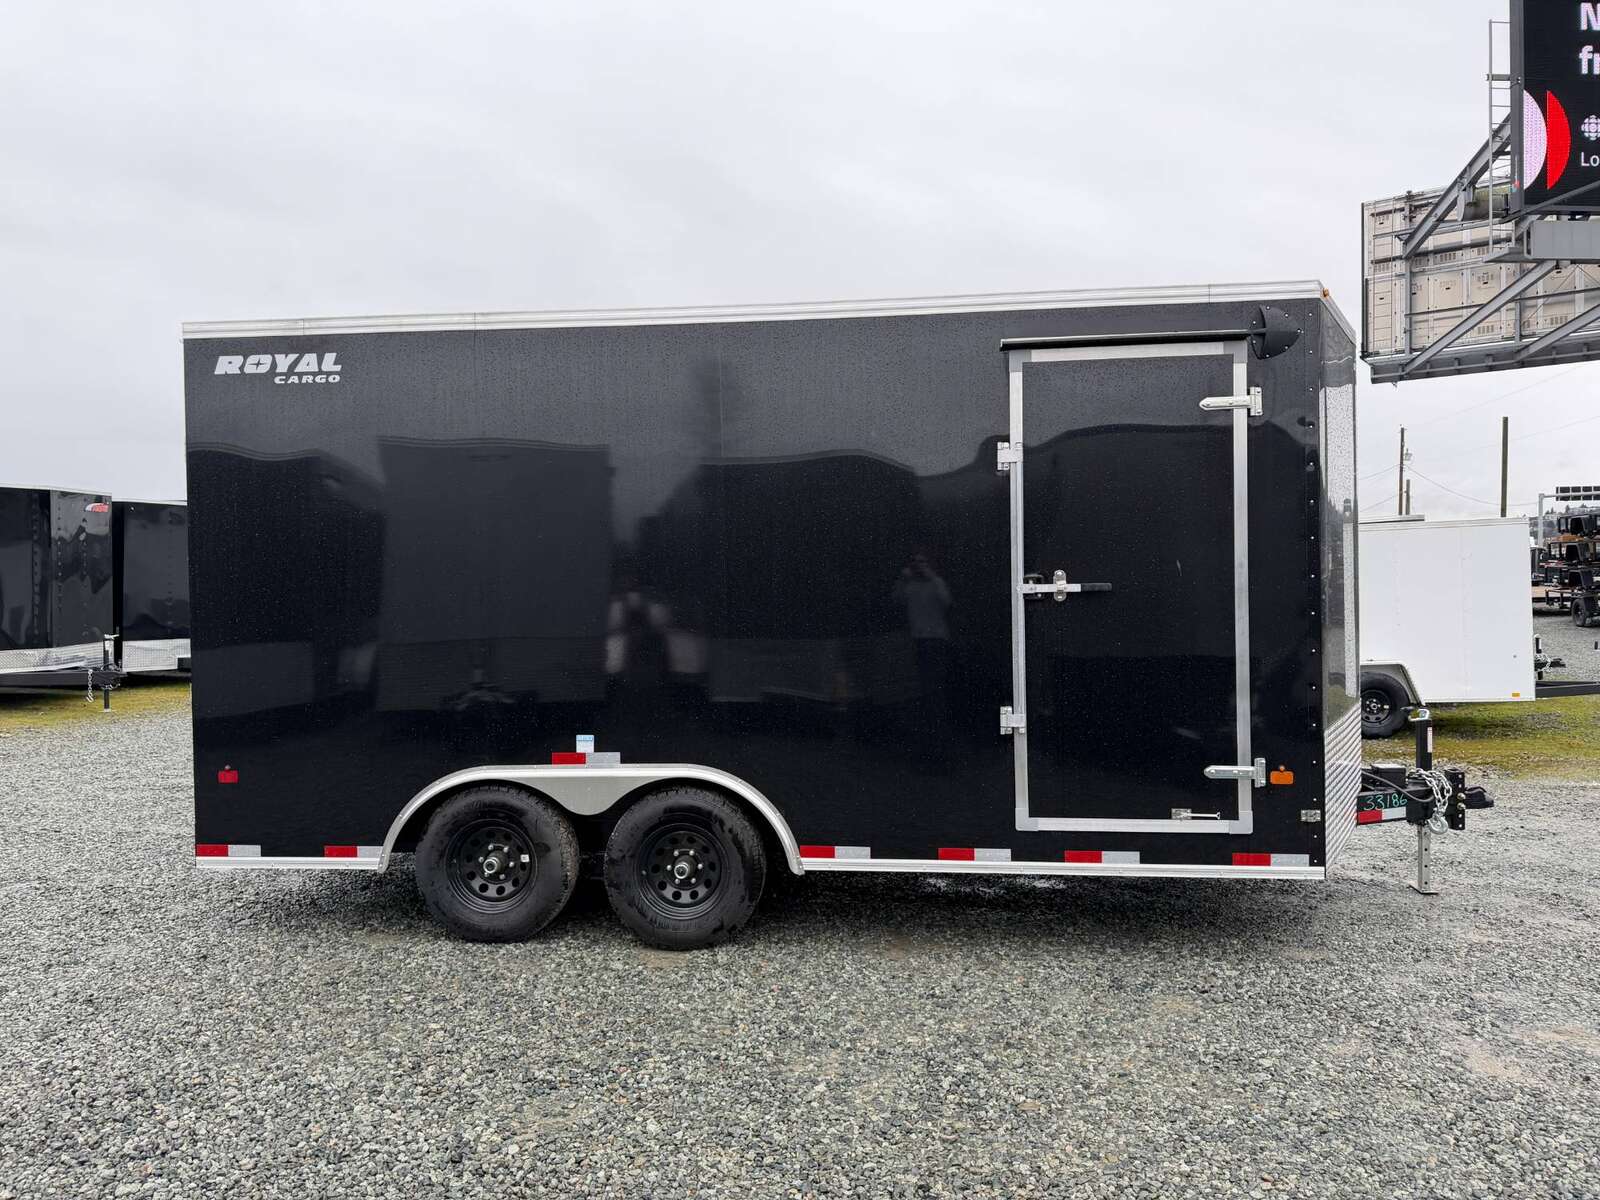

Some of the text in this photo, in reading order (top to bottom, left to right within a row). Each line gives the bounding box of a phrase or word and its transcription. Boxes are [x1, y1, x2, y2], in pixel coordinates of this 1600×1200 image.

[1581, 151, 1600, 167] Lo
[214, 352, 342, 375] ROYAL
[273, 374, 341, 384] CARGO
[1363, 793, 1408, 811] 33186
